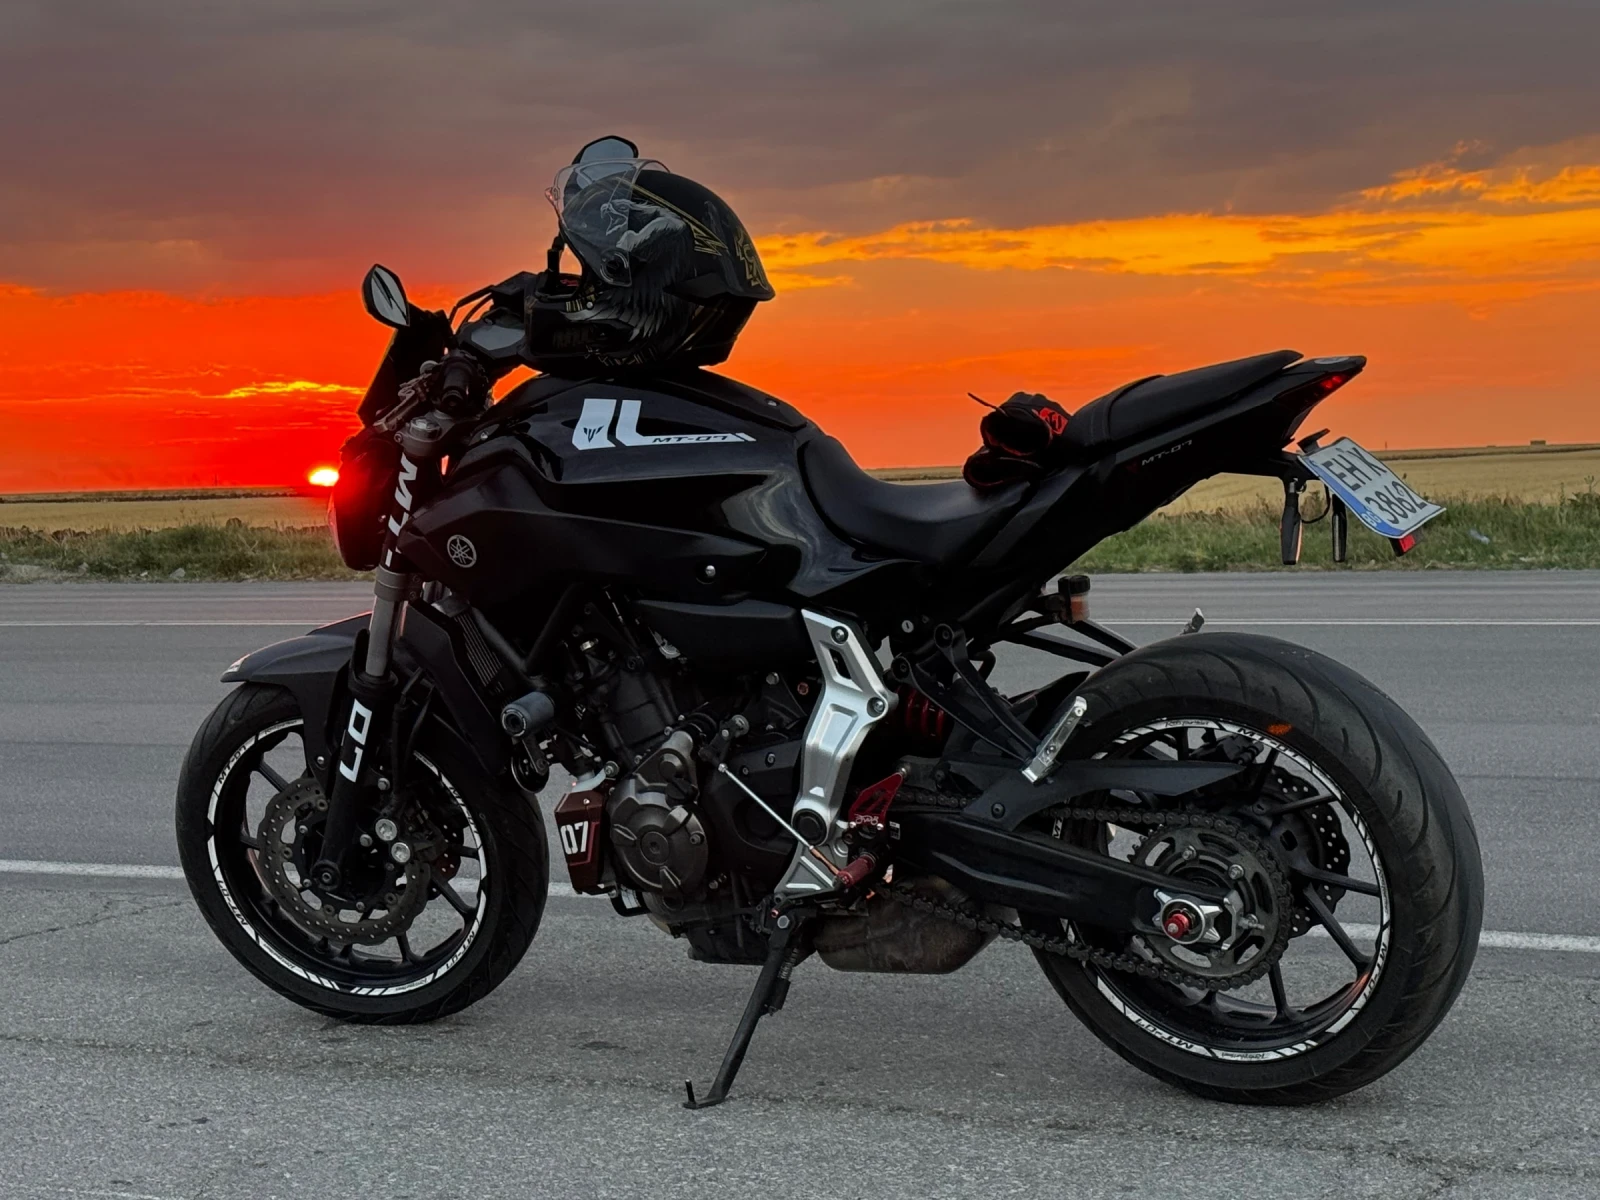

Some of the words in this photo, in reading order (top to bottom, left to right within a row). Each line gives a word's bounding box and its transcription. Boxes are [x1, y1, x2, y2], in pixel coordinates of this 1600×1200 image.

[652, 435, 728, 443] MT-07
[1141, 439, 1193, 467] MT-07
[1322, 447, 1387, 491] EHX
[1365, 481, 1428, 525] 3862
[1237, 728, 1299, 757] MT-07
[218, 745, 246, 784] MT-07
[560, 821, 589, 855] 07
[217, 880, 248, 925] MT-07
[446, 931, 475, 969] MT-07
[1363, 943, 1388, 1001] MT-07
[1135, 1018, 1194, 1050] MT-07
